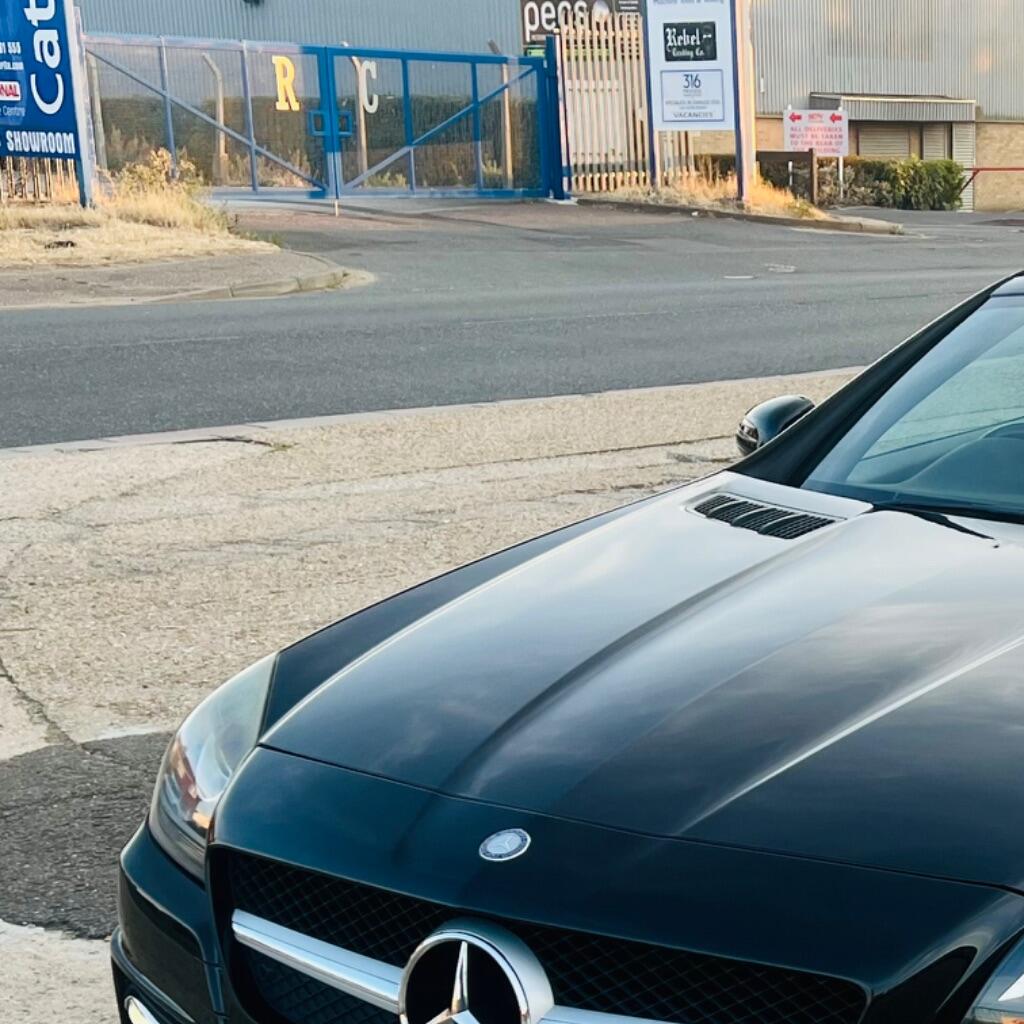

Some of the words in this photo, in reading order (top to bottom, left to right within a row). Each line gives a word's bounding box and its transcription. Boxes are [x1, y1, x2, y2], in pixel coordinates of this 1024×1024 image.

[665, 27, 701, 46] Rebel
[272, 55, 300, 111] R
[683, 74, 702, 88] 316
[6, 130, 75, 154] SHOWROOM
